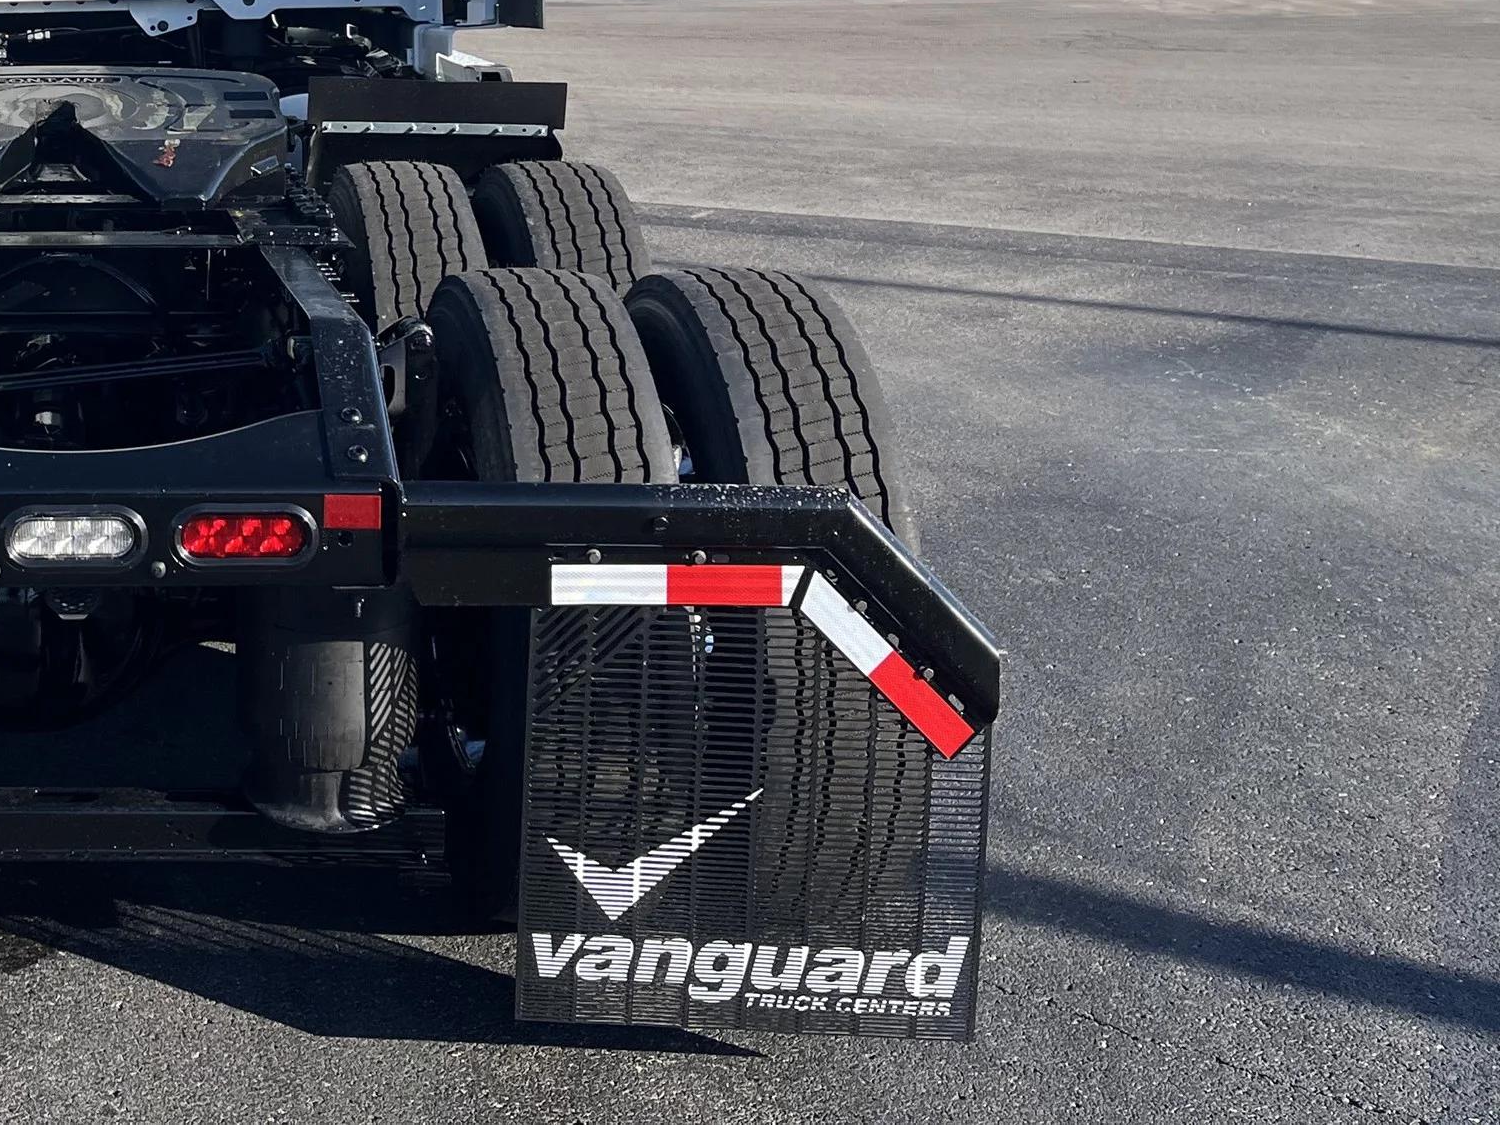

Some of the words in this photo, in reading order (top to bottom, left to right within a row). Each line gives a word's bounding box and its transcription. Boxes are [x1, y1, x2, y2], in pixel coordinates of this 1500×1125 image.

[531, 932, 970, 1003] vanguard
[744, 992, 829, 1012] TRUCK
[836, 997, 952, 1017] CENTERS
